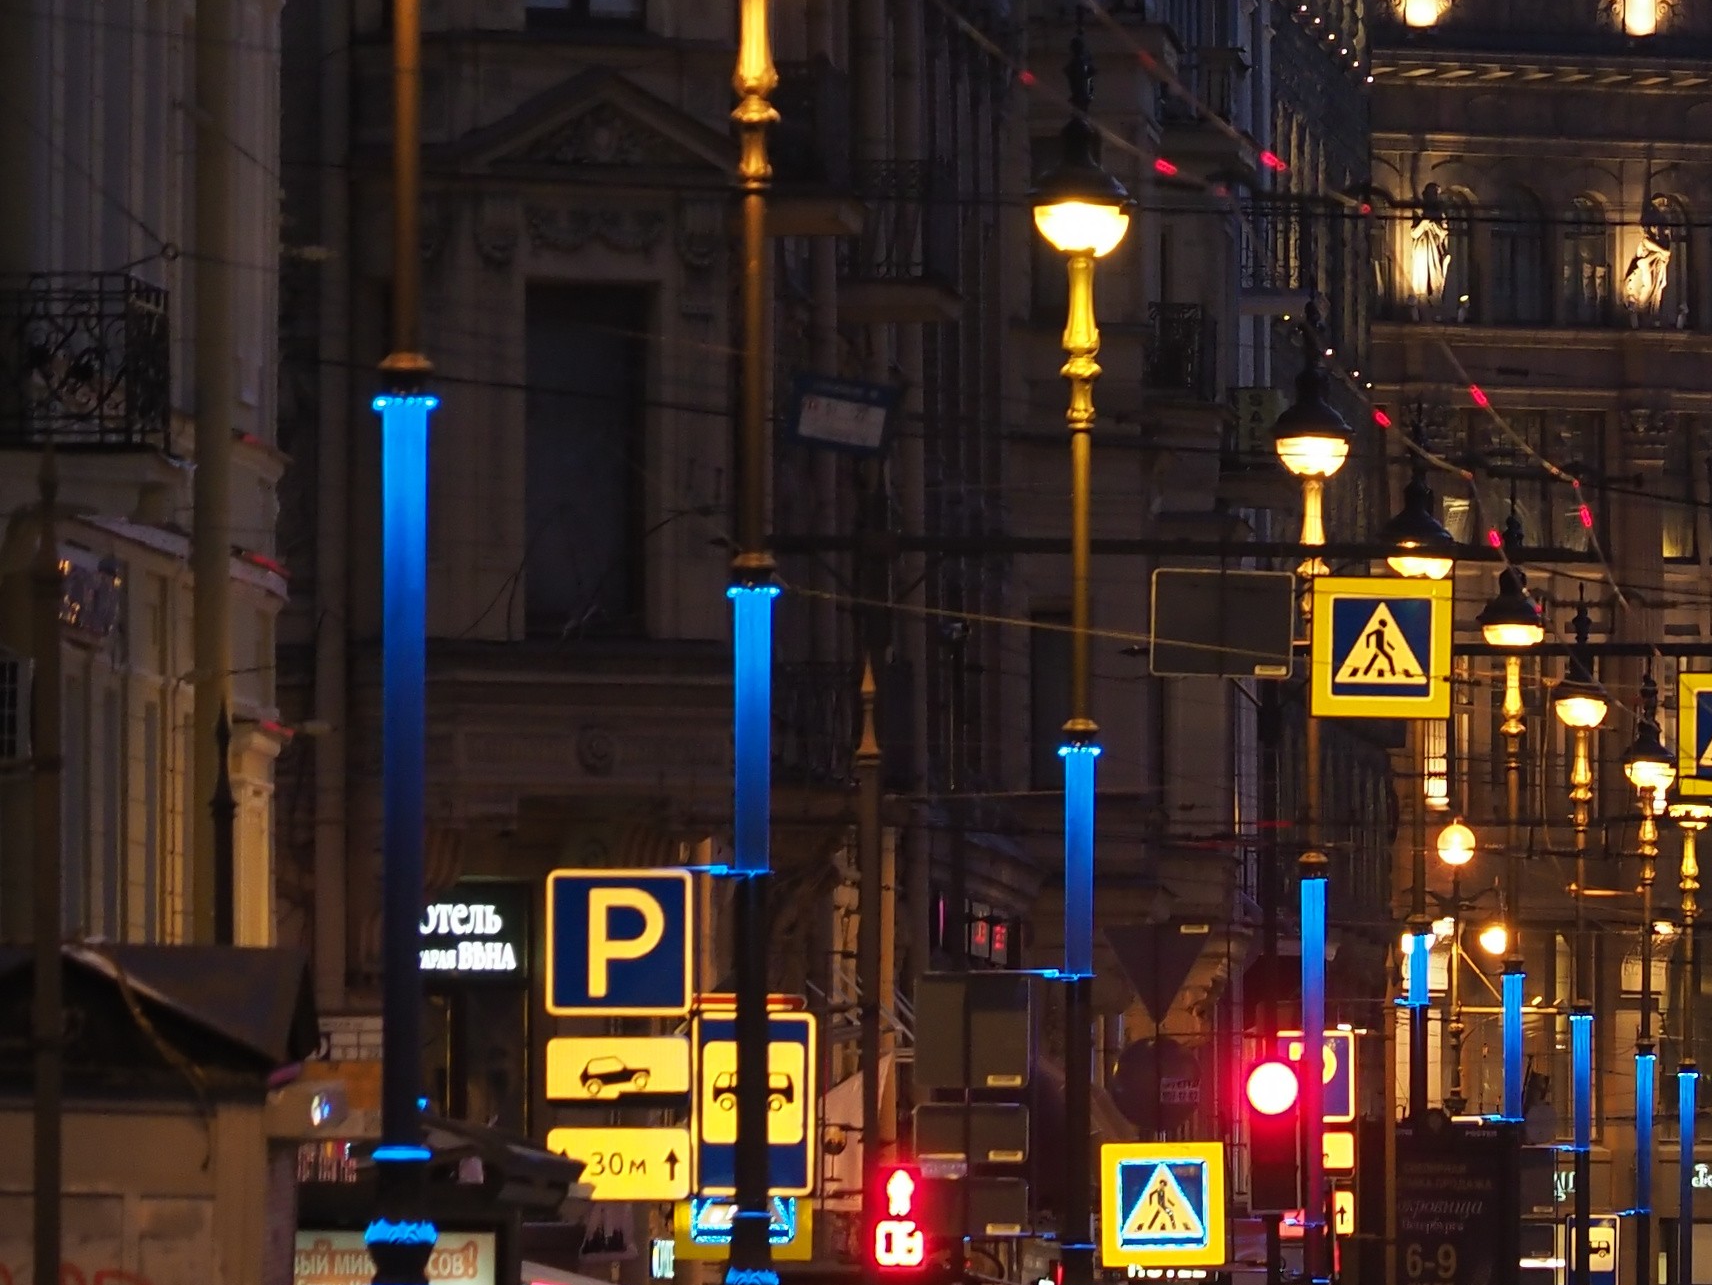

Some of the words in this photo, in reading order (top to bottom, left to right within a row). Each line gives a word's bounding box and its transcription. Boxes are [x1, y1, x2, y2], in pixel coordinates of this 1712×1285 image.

[588, 887, 665, 998] P
[590, 1151, 647, 1177] 30м
[1407, 1242, 1457, 1279] 6-9
